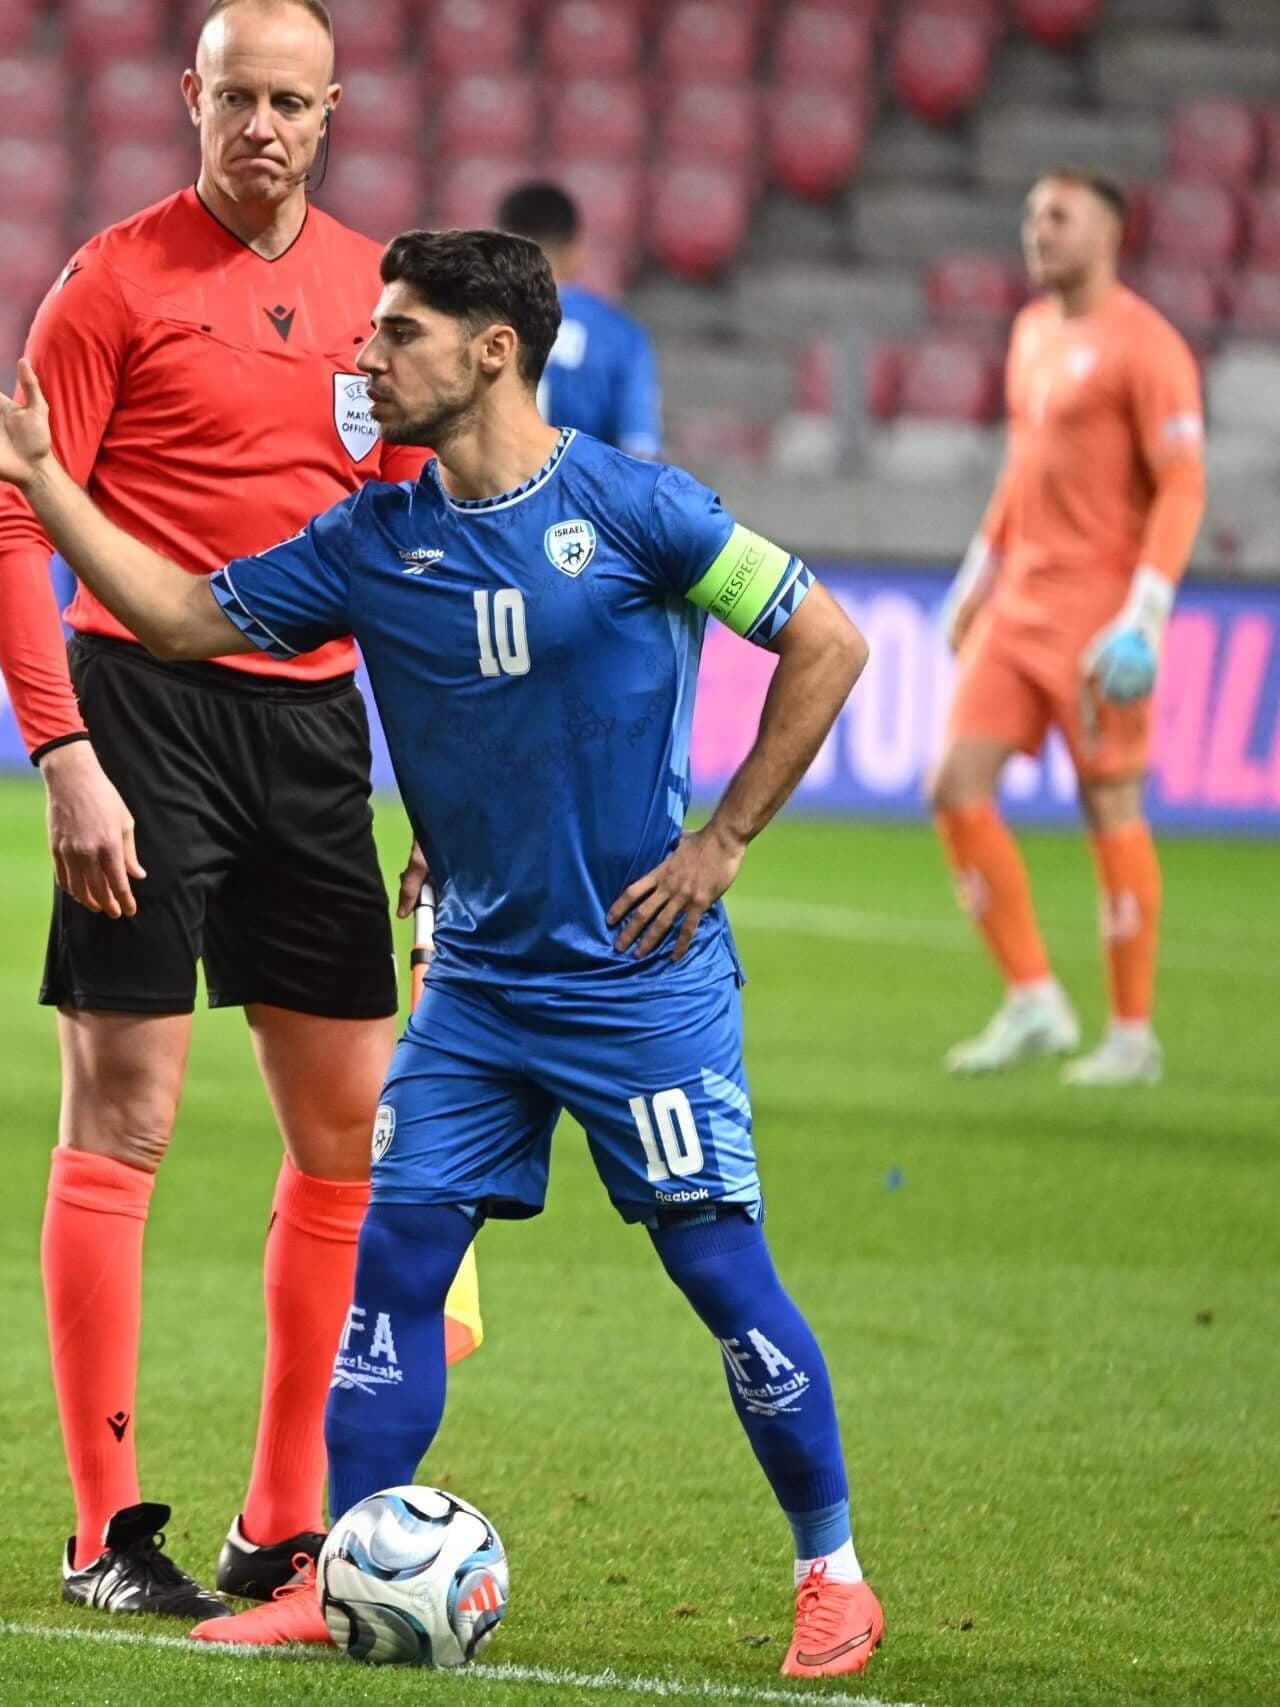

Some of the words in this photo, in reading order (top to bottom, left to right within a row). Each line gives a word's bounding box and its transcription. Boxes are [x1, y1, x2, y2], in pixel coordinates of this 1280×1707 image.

[554, 525, 585, 537] ISRAEL
[398, 547, 445, 560] Reebok
[720, 546, 761, 606] RESPECT
[473, 588, 531, 677] 10
[628, 1087, 704, 1182] 10
[655, 1187, 710, 1202] Reebok
